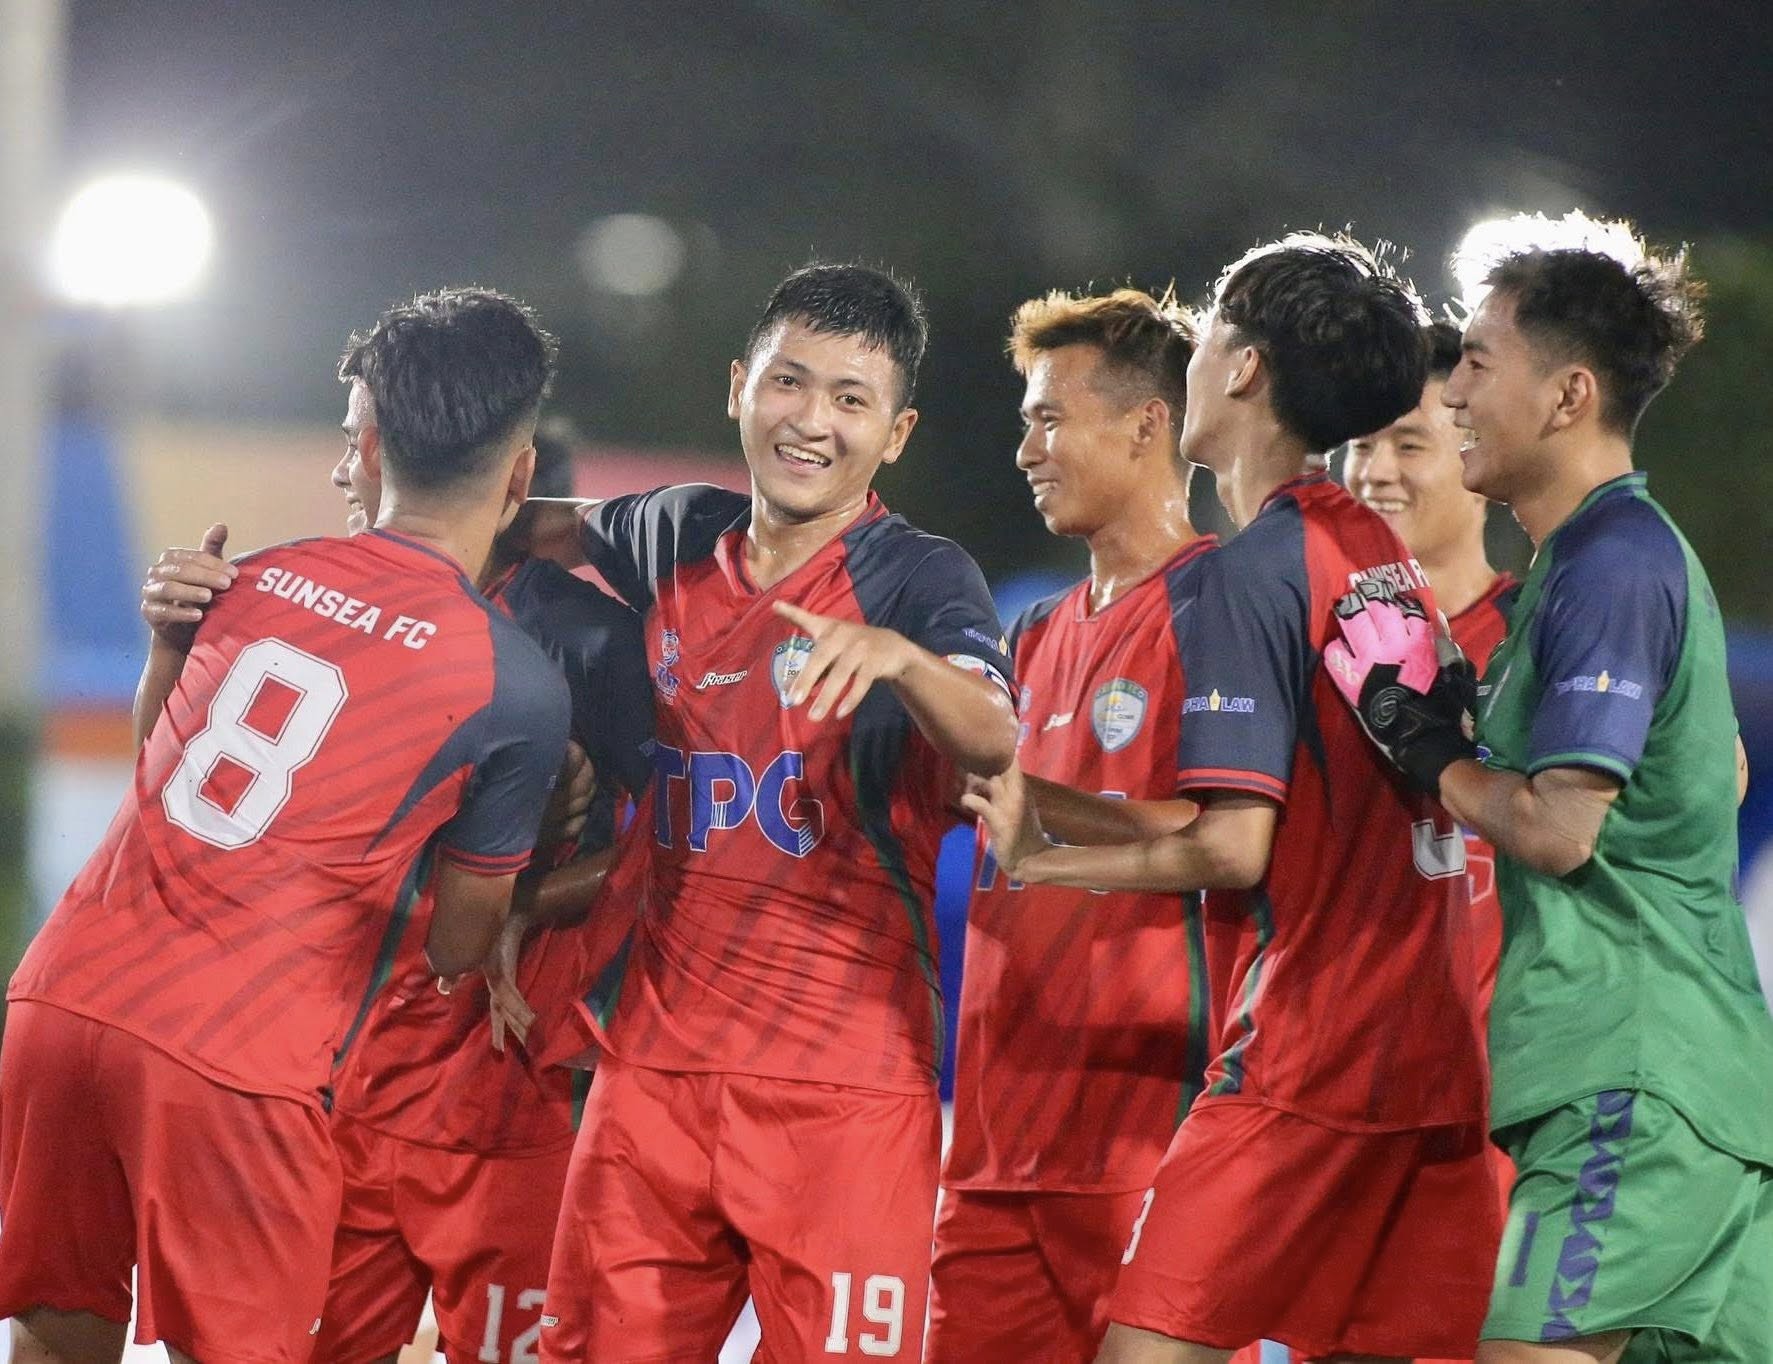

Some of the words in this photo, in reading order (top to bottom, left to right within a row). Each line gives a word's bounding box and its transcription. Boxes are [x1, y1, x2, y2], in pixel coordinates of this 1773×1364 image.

[255, 567, 382, 635] SUNSEA
[383, 615, 438, 650] FC
[160, 636, 350, 851] 8
[639, 739, 825, 858] TPG
[478, 1283, 548, 1364] 12
[824, 1271, 906, 1357] 19
